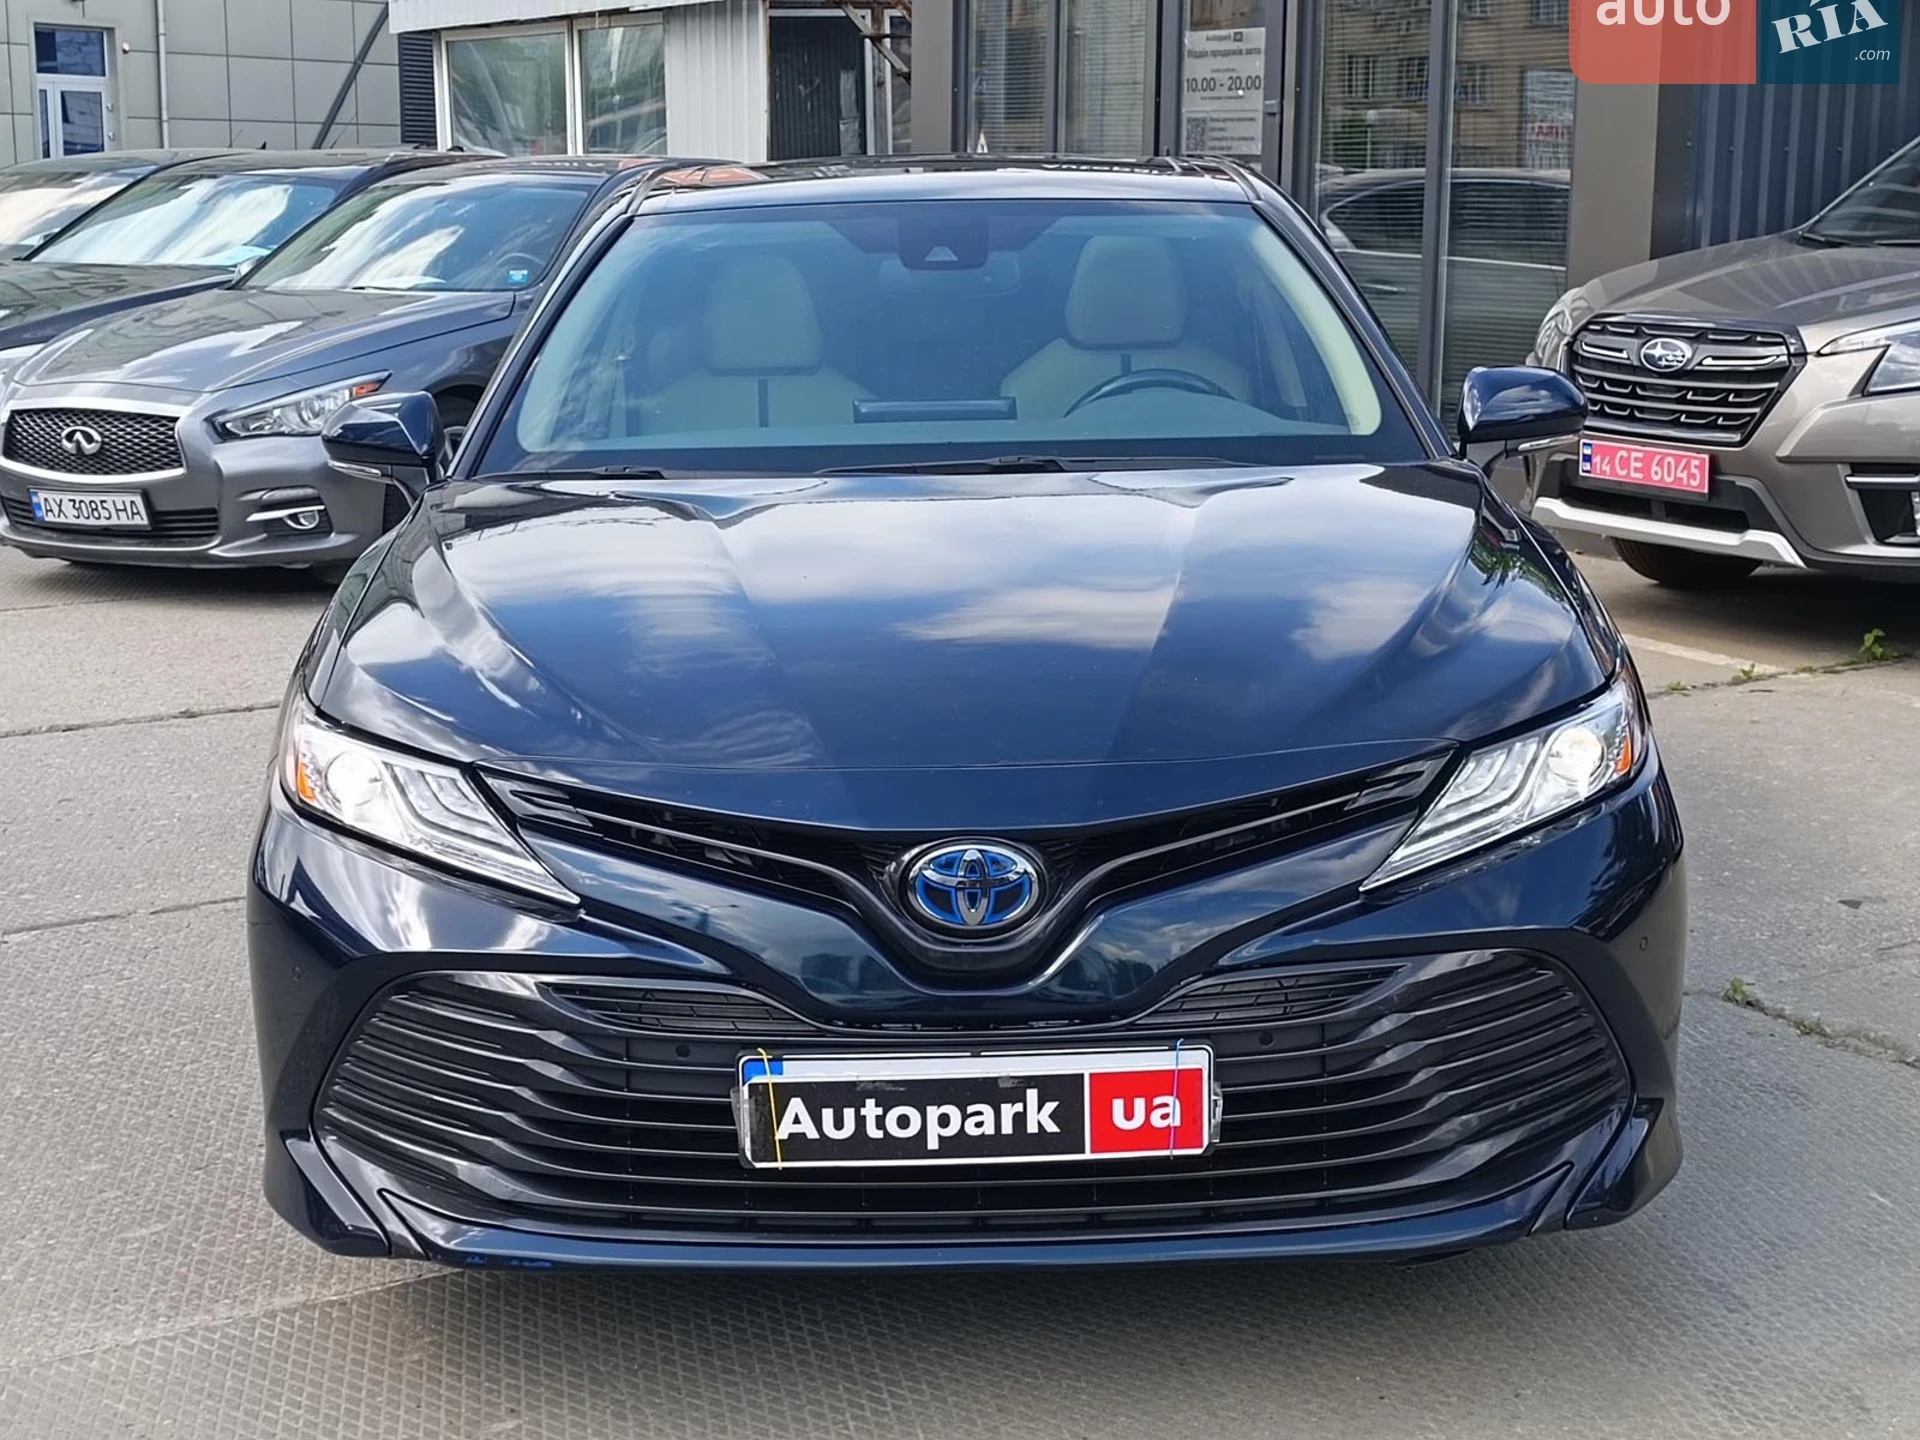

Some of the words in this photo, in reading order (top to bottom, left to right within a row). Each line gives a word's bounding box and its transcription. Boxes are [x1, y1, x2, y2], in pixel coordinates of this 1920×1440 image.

[1186, 76, 1217, 92] 10.00
[1227, 75, 1262, 91] 20.00
[1593, 455, 1611, 476] 14
[1615, 449, 1644, 478] CE
[1651, 455, 1701, 487] 6045
[43, 497, 69, 519] AX
[68, 499, 112, 521] 3085
[113, 500, 144, 521] HA
[776, 1088, 1061, 1151] Autopark
[1111, 1094, 1182, 1130] ua
